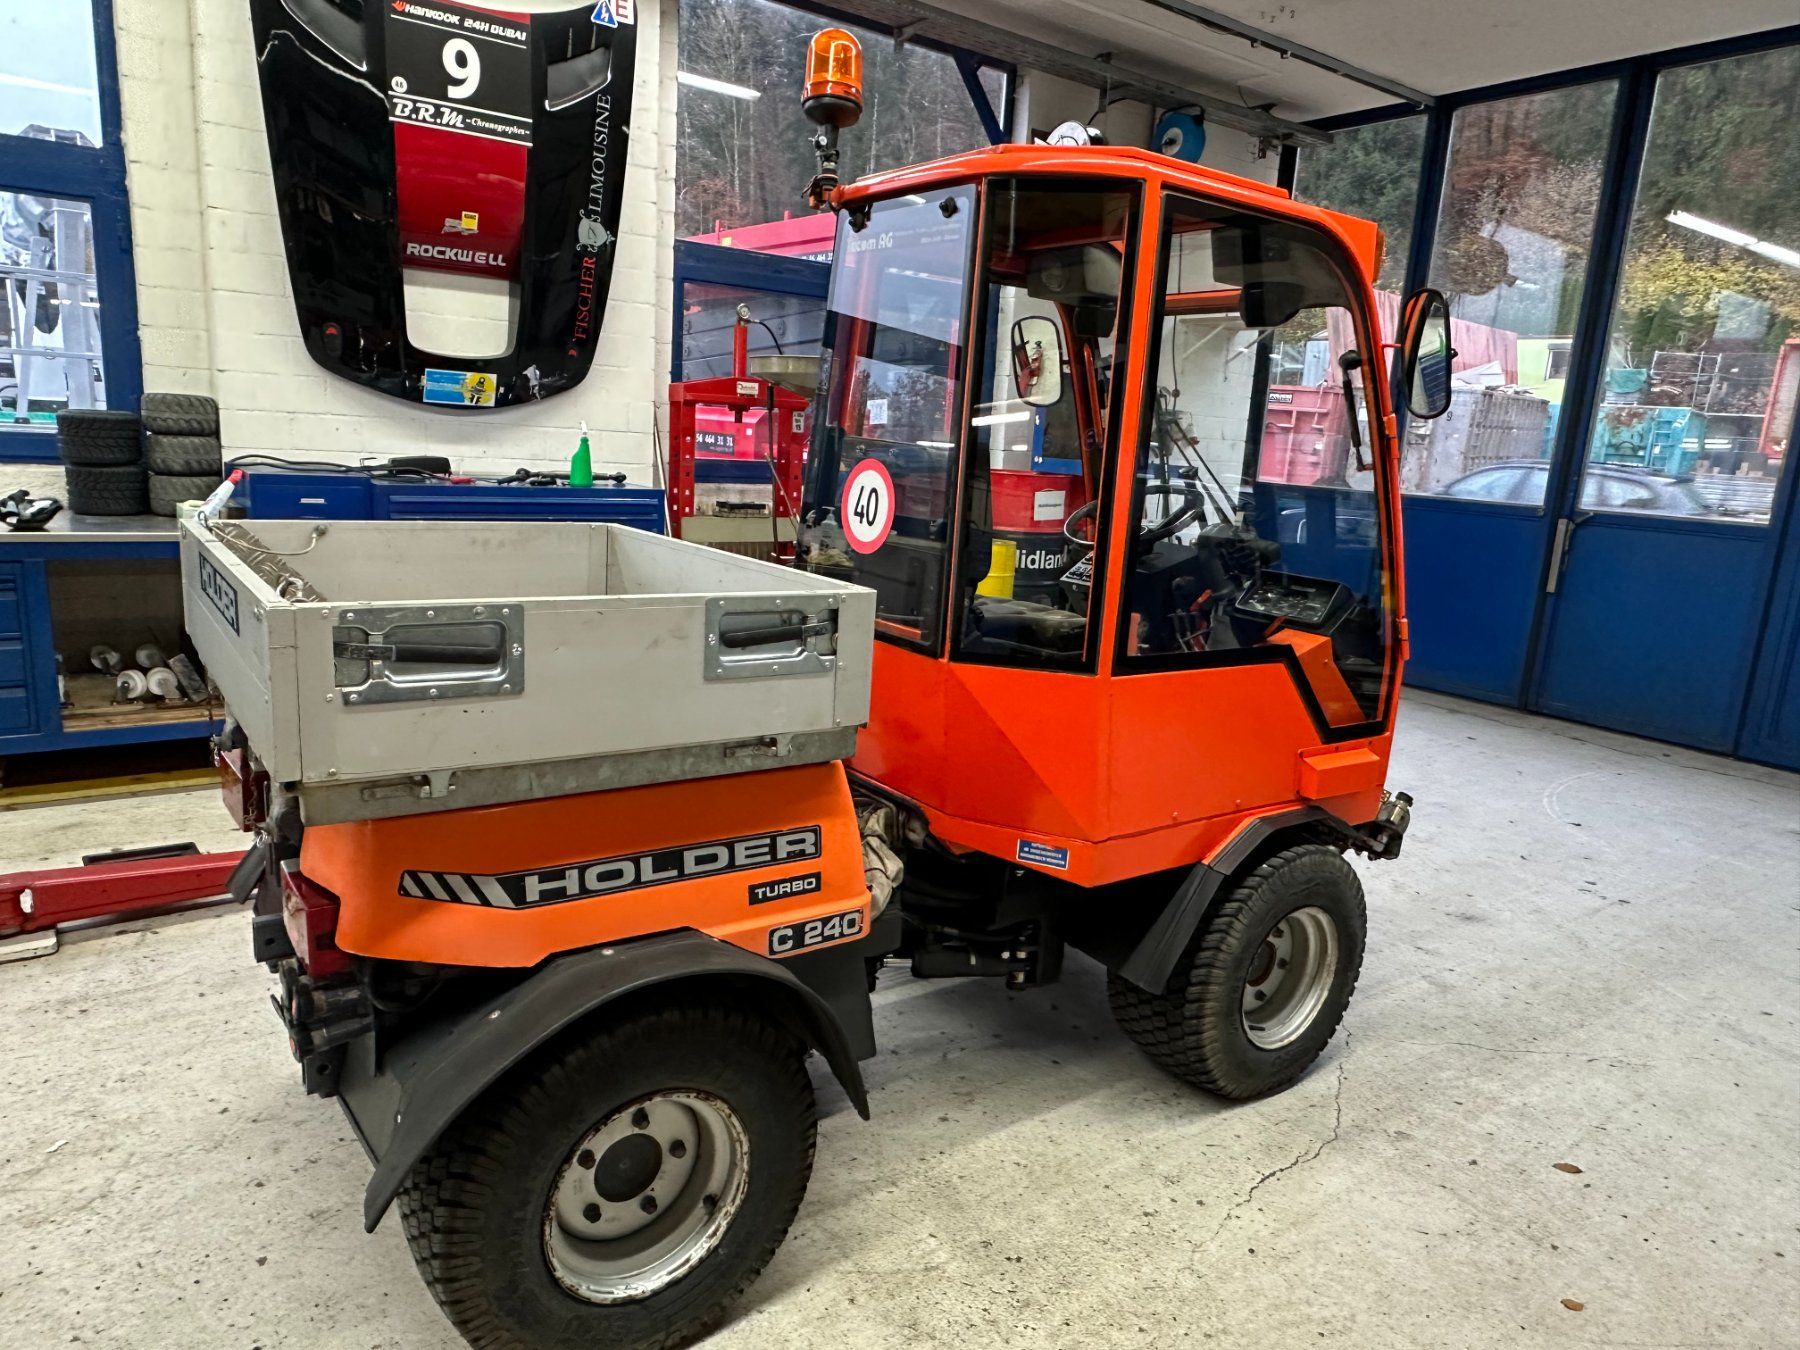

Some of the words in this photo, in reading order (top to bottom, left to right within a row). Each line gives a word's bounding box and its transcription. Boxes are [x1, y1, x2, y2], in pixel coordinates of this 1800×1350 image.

[464, 18, 489, 32] 24H
[490, 24, 527, 41] DUBAI
[442, 37, 481, 99] 9
[589, 94, 611, 215] LIMOUSINE
[406, 242, 507, 267] ROCKWELL
[878, 232, 894, 249] AG
[574, 256, 597, 339] FISCHER
[705, 434, 715, 444] 464
[853, 485, 879, 527] 40
[524, 830, 817, 903] HOLDER
[754, 877, 817, 900] TURBO
[772, 927, 794, 953] C
[803, 911, 861, 946] 240
